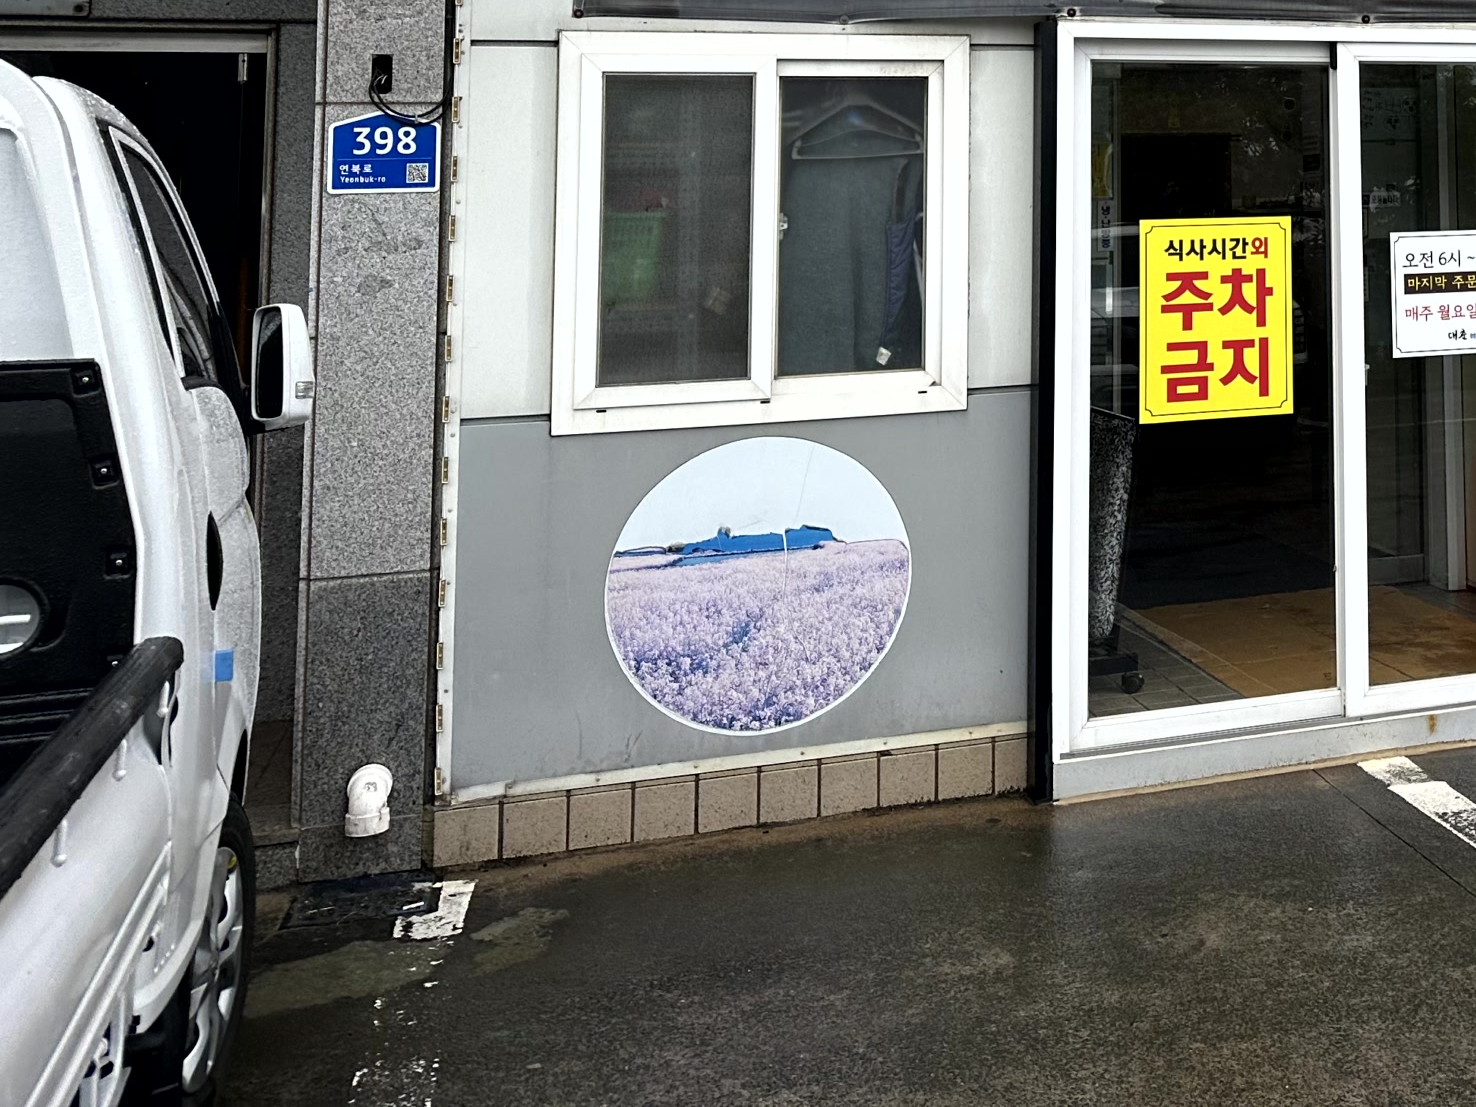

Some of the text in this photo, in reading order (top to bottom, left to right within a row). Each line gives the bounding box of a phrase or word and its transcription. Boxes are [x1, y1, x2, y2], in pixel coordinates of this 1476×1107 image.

[352, 126, 417, 155] 398
[339, 164, 373, 174] 연북로
[1402, 250, 1434, 269] 오전
[1438, 249, 1461, 268] 6시
[1407, 276, 1447, 291] 마지막
[1160, 268, 1274, 330] 주차
[1405, 306, 1433, 322] 매주
[1160, 336, 1270, 403] 금지
